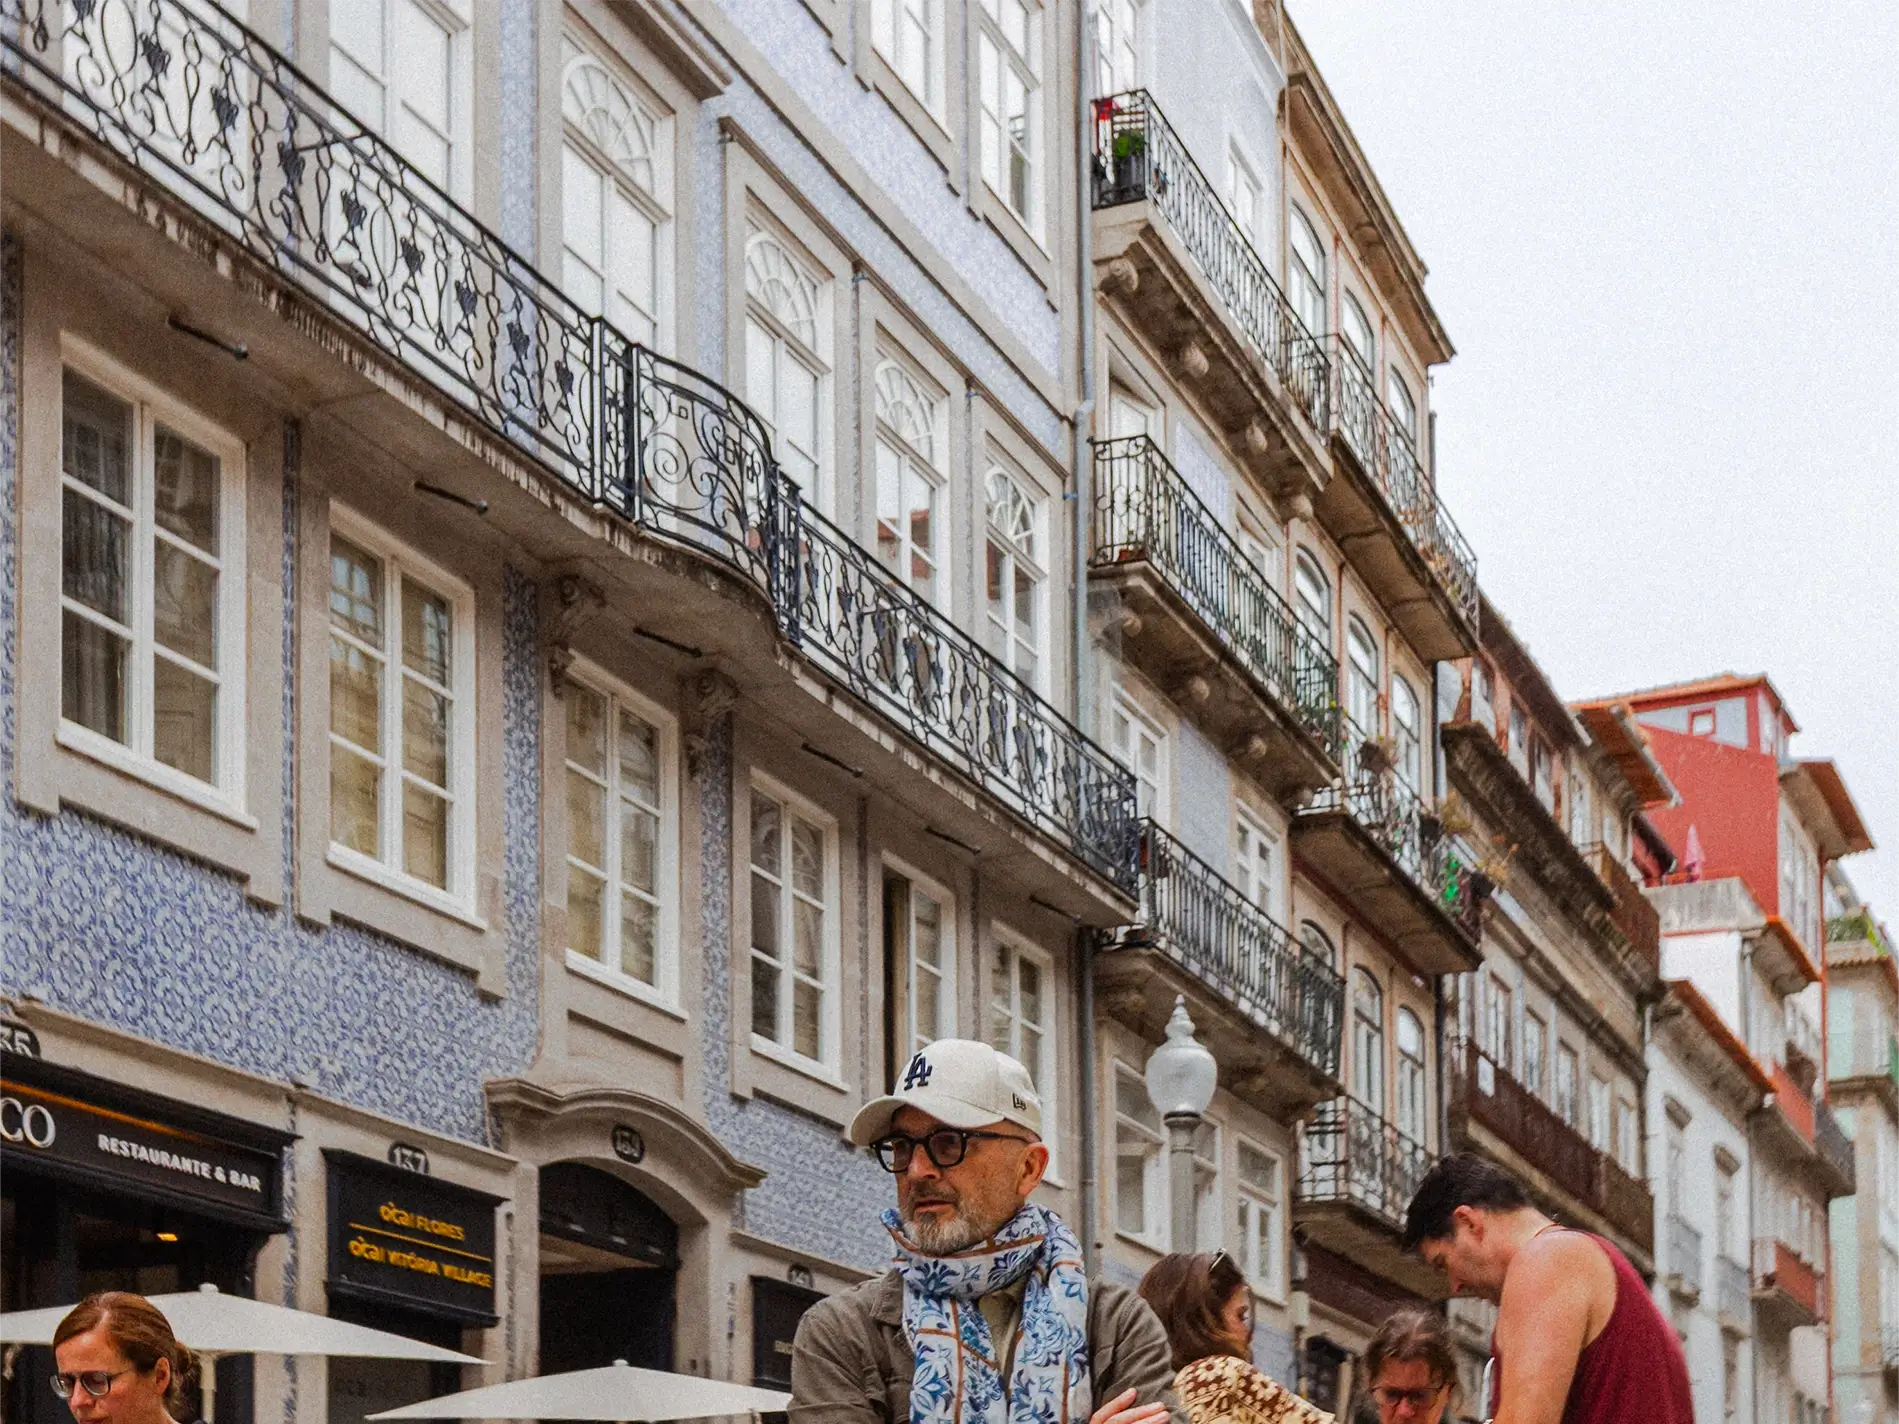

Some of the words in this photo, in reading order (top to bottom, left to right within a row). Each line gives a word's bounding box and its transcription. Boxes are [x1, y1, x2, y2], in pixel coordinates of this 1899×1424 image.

[904, 1053, 932, 1091] LA
[98, 1134, 212, 1179] RESTAURANTE
[214, 1166, 227, 1183] &
[229, 1170, 262, 1193] BAR
[393, 1147, 426, 1175] 137
[416, 1215, 465, 1241] FLORES
